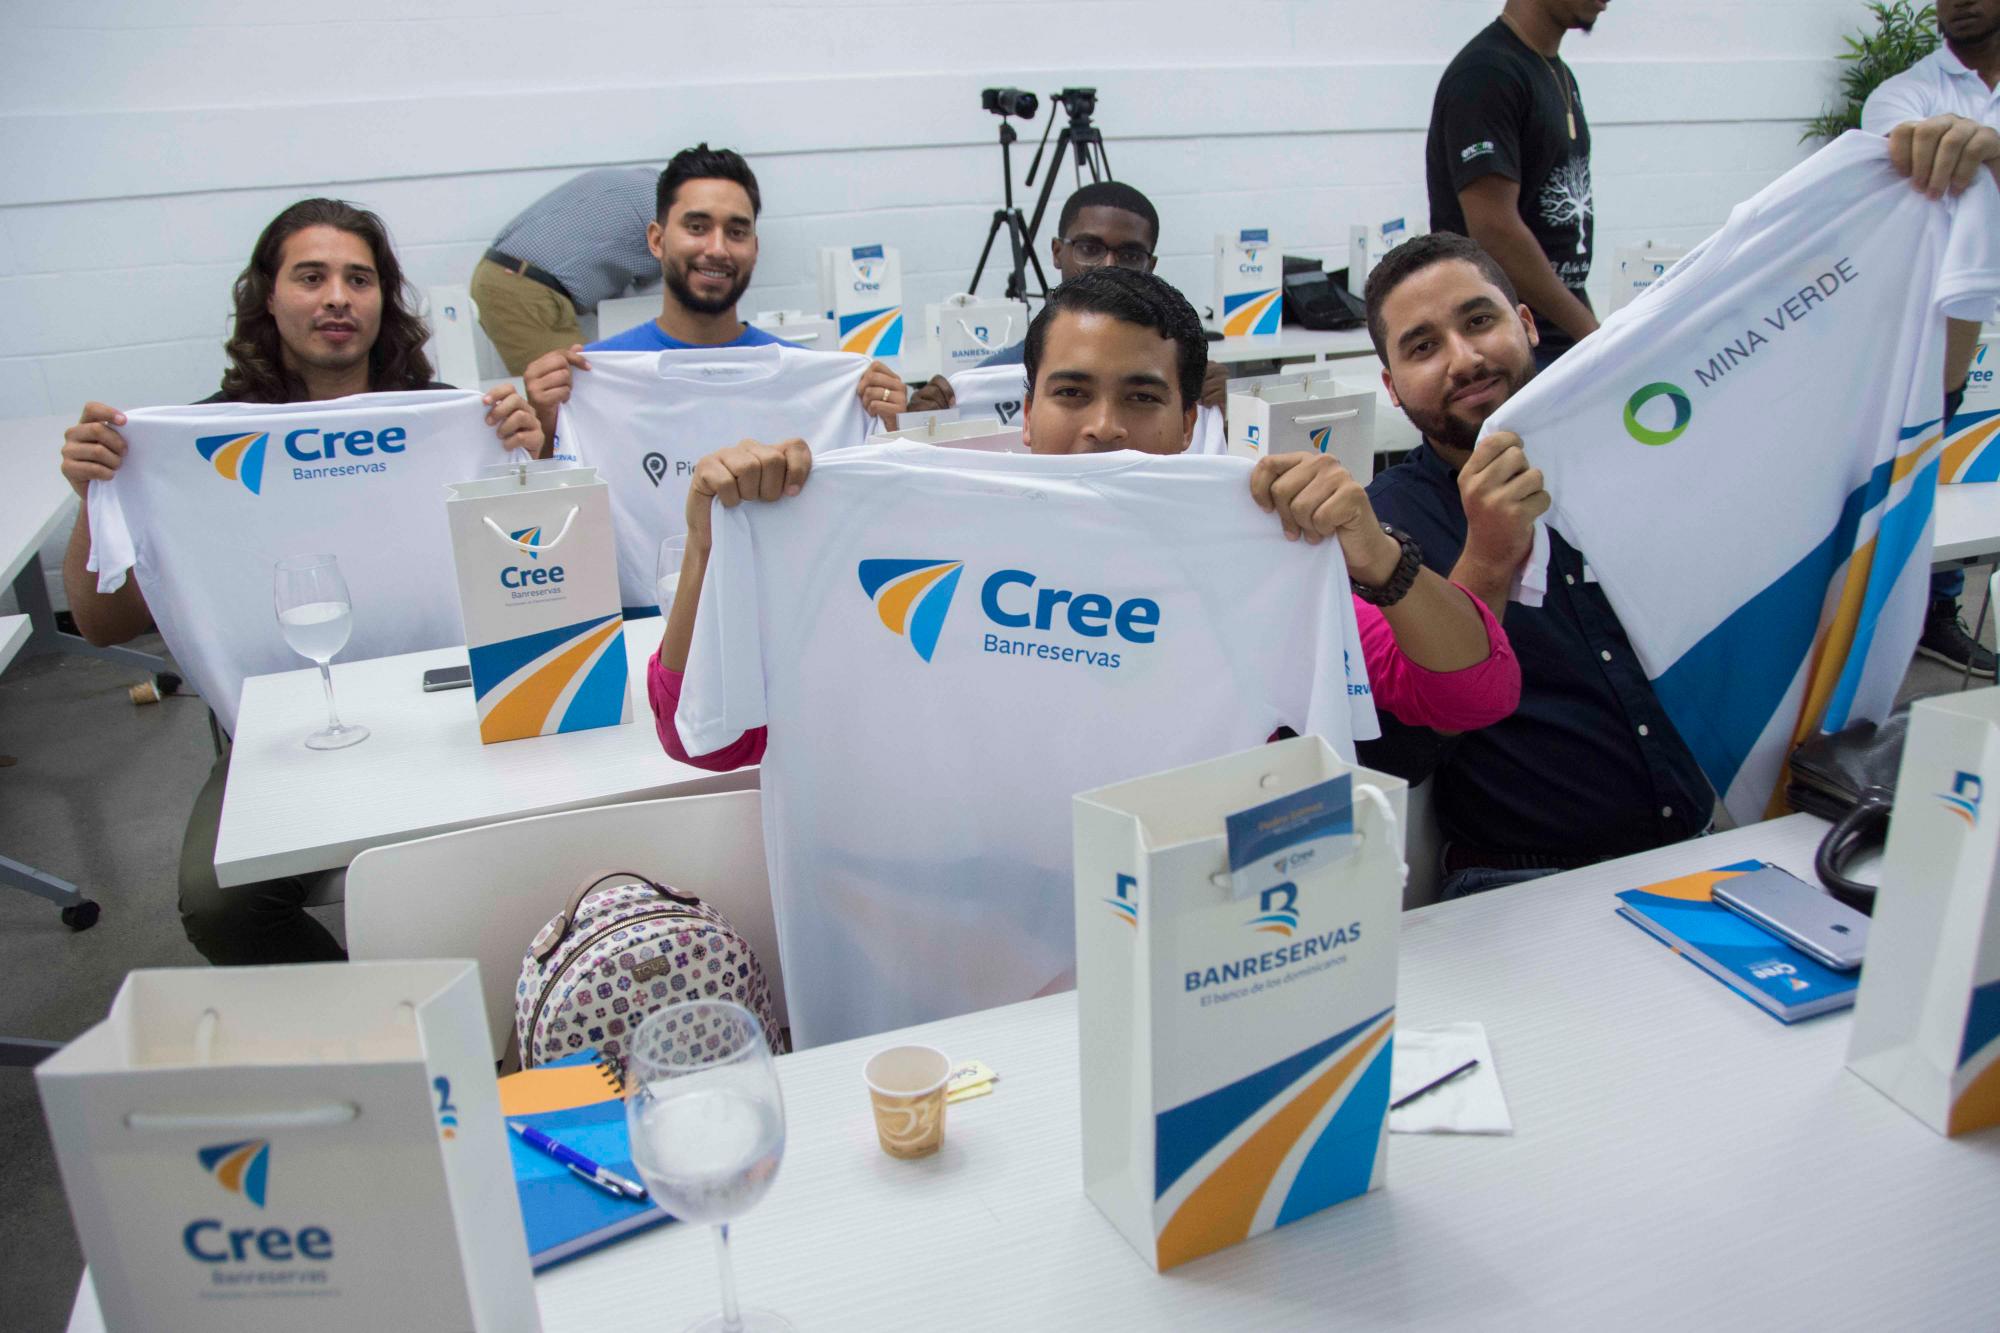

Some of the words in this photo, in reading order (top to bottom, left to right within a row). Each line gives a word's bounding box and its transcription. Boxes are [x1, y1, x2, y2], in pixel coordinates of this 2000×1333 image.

[1694, 330, 1769, 388] MINA
[1763, 257, 1859, 322] VERDE
[1967, 370, 1993, 382] ree
[284, 426, 407, 462] Cree
[293, 462, 387, 480] Banreservas
[500, 565, 565, 589] Cree
[511, 587, 562, 599] Banreservas
[980, 569, 1160, 644] Cree
[984, 633, 1121, 669] Banreservas
[1185, 921, 1361, 992] BANRESERVAS
[182, 1217, 334, 1263] Cree
